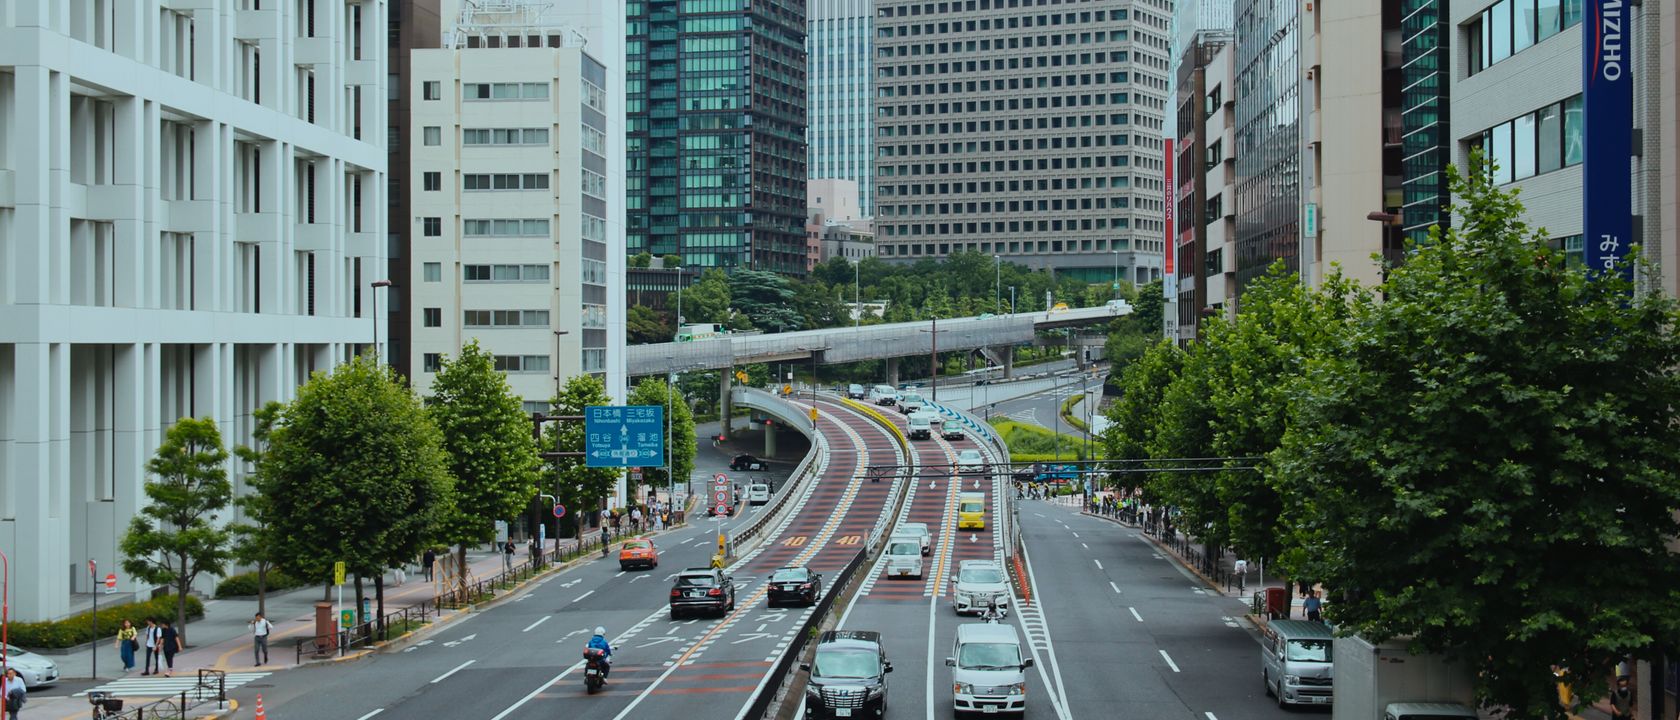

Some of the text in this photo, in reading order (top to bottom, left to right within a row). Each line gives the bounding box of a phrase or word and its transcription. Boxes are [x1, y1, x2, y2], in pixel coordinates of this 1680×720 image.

[594, 409, 621, 418] 日本橋
[626, 408, 654, 418] 三宅坂
[590, 433, 612, 442] 四谷
[637, 432, 659, 442] 溜池
[780, 536, 808, 546] 40
[835, 535, 861, 545] 40
